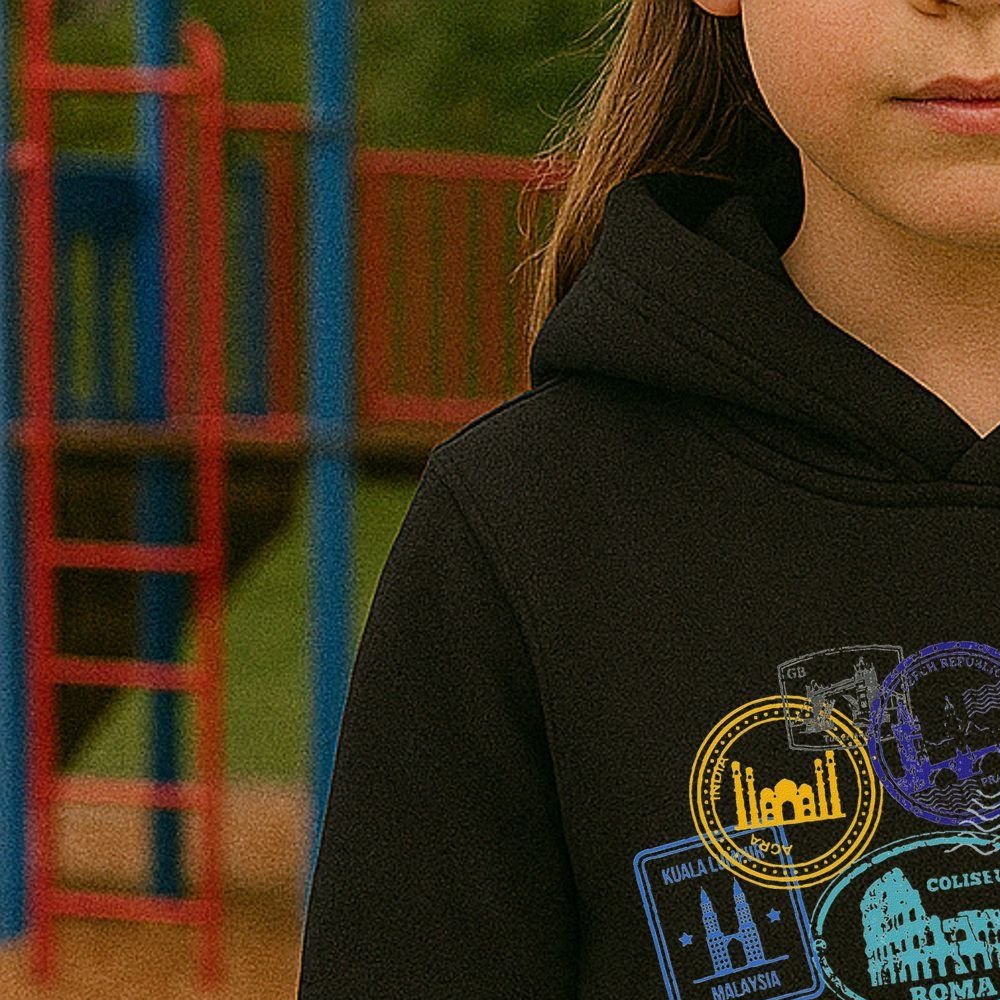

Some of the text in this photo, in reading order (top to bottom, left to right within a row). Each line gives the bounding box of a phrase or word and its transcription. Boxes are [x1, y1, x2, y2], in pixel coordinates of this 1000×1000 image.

[786, 666, 807, 680] GB
[711, 758, 729, 801] INDIA
[750, 833, 793, 856] AGRA
[661, 858, 708, 886] KUALA
